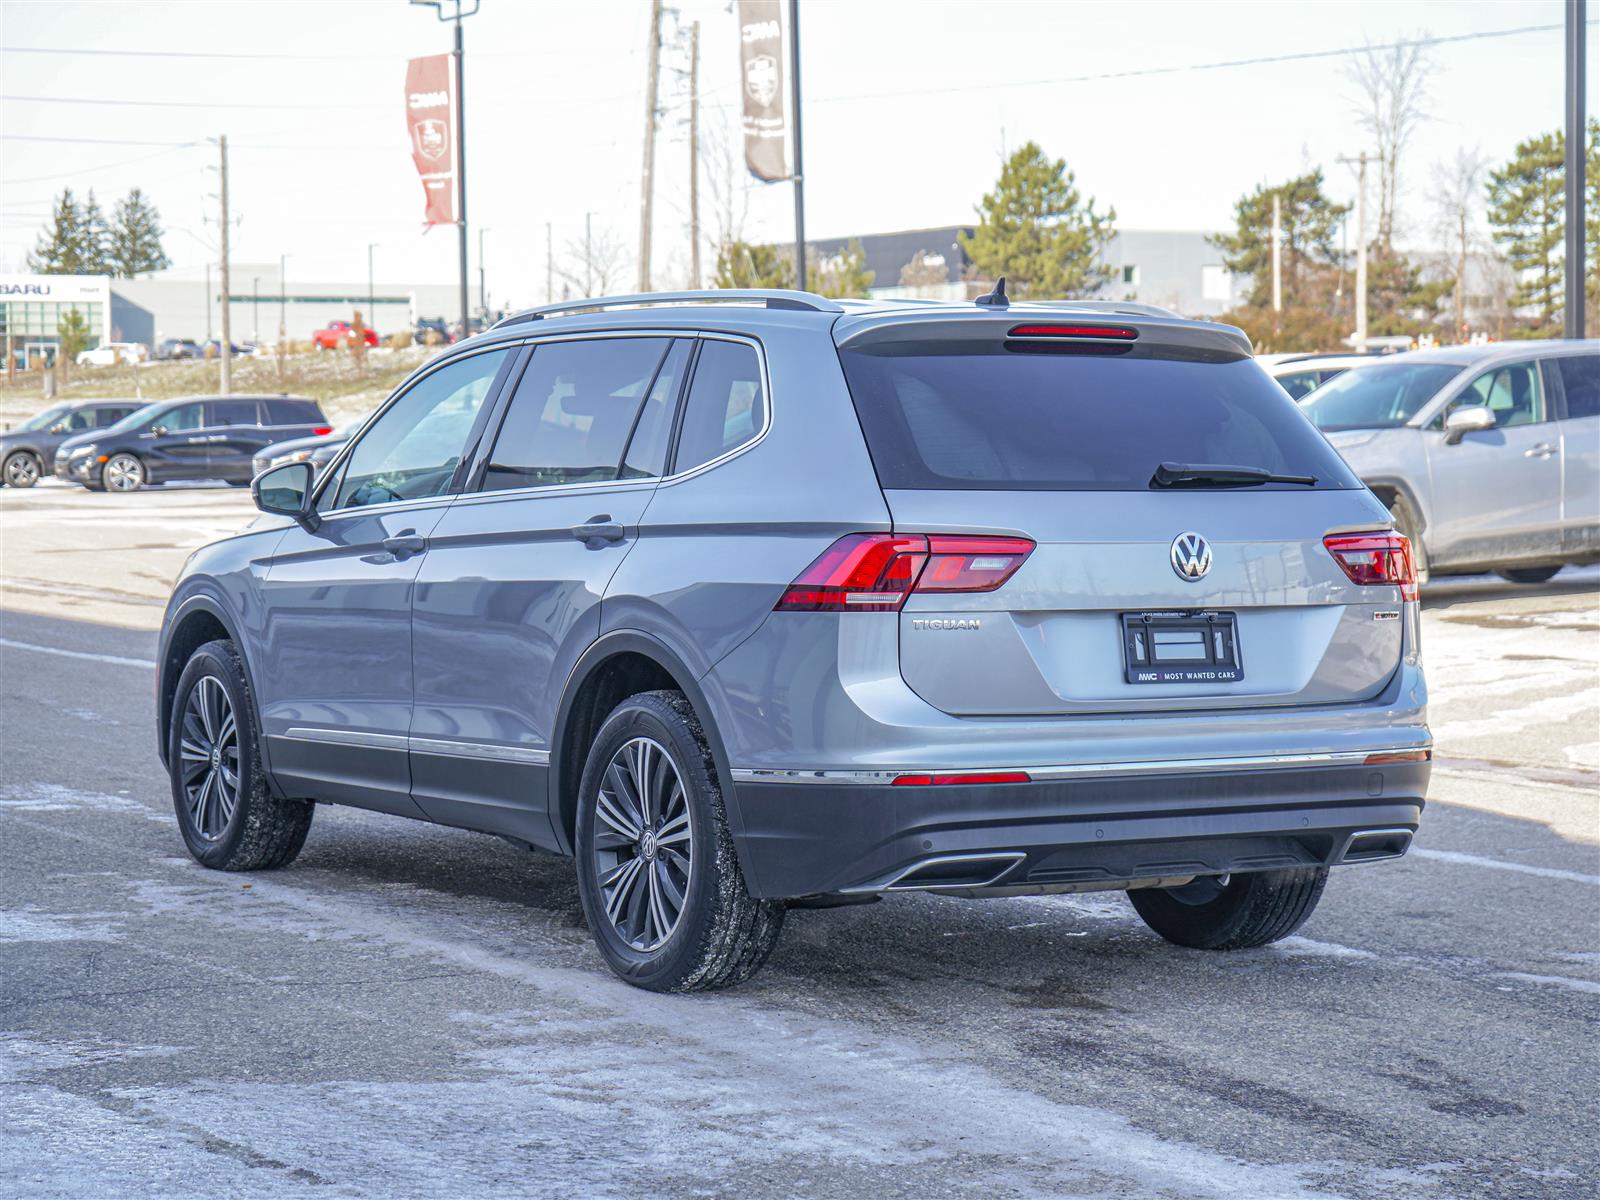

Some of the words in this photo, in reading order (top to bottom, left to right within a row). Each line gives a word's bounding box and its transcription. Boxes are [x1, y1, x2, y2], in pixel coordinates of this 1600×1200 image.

[912, 619, 981, 631] TIGUAN
[1164, 672, 1184, 680] MOST
[1186, 672, 1216, 680] WANTED
[1218, 671, 1236, 679] CARS
